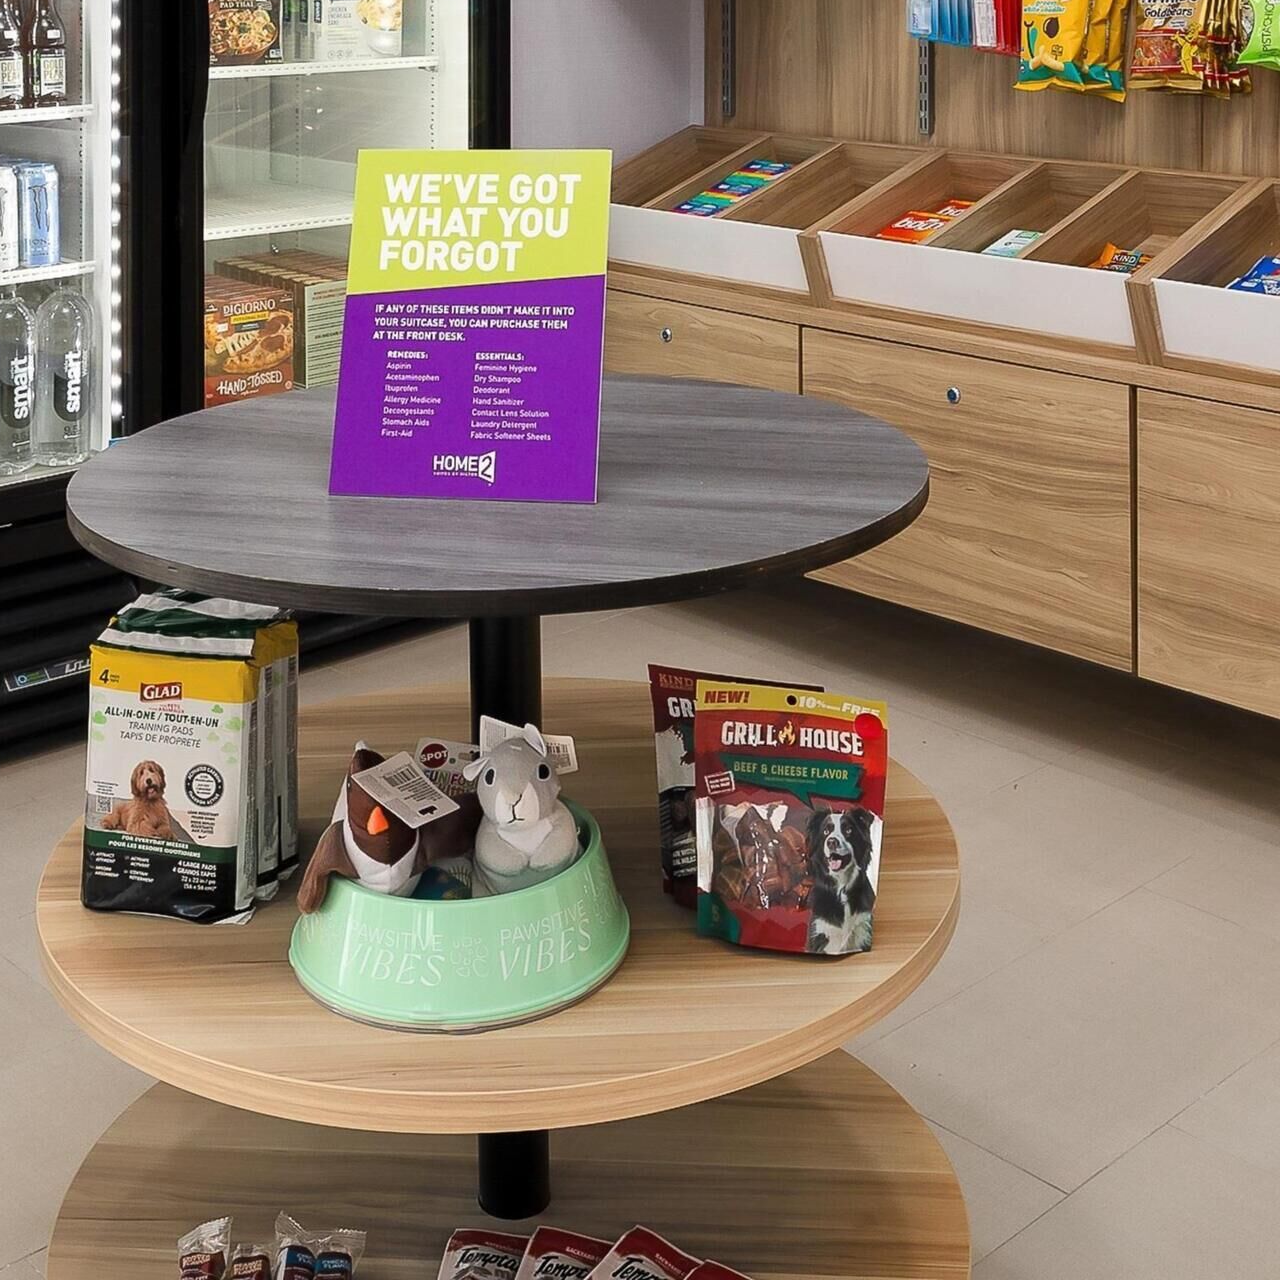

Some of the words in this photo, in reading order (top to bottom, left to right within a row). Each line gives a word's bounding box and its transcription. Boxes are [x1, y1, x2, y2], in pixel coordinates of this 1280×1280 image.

[1144, 7, 1193, 18] Goldbears
[384, 173, 499, 204] WE'VE
[509, 173, 582, 205] GOT
[382, 207, 488, 238] WHAT
[498, 207, 569, 238] YOU
[378, 240, 524, 273] FORGOT
[1112, 253, 1137, 265] KIND
[223, 299, 276, 317] DIGIORNO
[375, 304, 384, 313] IF
[386, 304, 405, 313] ANY
[406, 304, 418, 313] OF
[420, 305, 450, 314] THESE
[451, 305, 479, 315] ITEMS
[481, 305, 512, 315] DIDN'T
[514, 306, 540, 315] MAKE
[542, 306, 551, 315] IT
[552, 306, 575, 315] INTO
[374, 317, 399, 327] YOUR
[400, 318, 447, 328] SUITCASE,
[449, 319, 468, 328] YOU
[469, 319, 488, 328] CAN
[490, 320, 540, 329] PURCHASE
[542, 320, 568, 329] THEM
[373, 331, 384, 340] AT
[386, 331, 404, 340] THE
[406, 331, 438, 341] FRONT
[439, 331, 466, 341] DESK.
[387, 351, 428, 359] REMEDIES:
[476, 352, 525, 361] ESSENTIALS:
[386, 362, 412, 371] Aspirin
[475, 363, 507, 371] Feminine
[508, 365, 537, 373] Hygiene
[66, 350, 81, 413] smart
[216, 370, 283, 396] HAND-TOSSED
[385, 373, 440, 382] Acetaminophen
[474, 375, 486, 384] Dry
[488, 375, 521, 384] Shampoo
[13, 355, 29, 421] smart
[385, 384, 418, 393] Ibuprofen
[473, 386, 510, 394] Deodorant
[384, 396, 409, 405] Allergy
[410, 396, 441, 404] Medicine
[472, 397, 491, 405] Hand
[493, 398, 524, 406] Sanitizer
[383, 407, 435, 416] Decongestants
[472, 409, 499, 417] Contact
[520, 410, 549, 418] Solution
[382, 418, 413, 426] Stomach
[414, 418, 430, 426] Aids
[471, 421, 500, 429] Laundry
[502, 421, 537, 430] Detergent
[381, 429, 413, 437] First-Aid
[470, 432, 493, 440] Fabric
[526, 433, 551, 441] Sheets
[99, 669, 110, 684] 4
[143, 684, 180, 700] GLAD
[704, 690, 750, 704] NEW!
[105, 706, 156, 721] ALL-IN-ONE
[164, 713, 219, 728] TOUT-EN-UN
[128, 721, 170, 733] TRAINING
[171, 725, 194, 736] PADS
[120, 731, 143, 741] TAPIS
[145, 733, 157, 742] DE
[721, 720, 779, 746] GRILL
[800, 727, 864, 756] HOUSE
[420, 750, 448, 762] SPOT
[733, 761, 758, 773] BEEF
[770, 764, 808, 777] CHEESE
[811, 767, 849, 780] FLAVOR
[108, 840, 126, 848] POUR
[135, 836, 165, 846] EVERYDAY
[183, 861, 201, 869] LARGE
[202, 863, 217, 871] PADS
[499, 899, 588, 946] PAWSITIVE
[349, 922, 443, 952] PAWSITIVE
[498, 919, 592, 981] VIBES
[340, 942, 446, 986] VIBES
